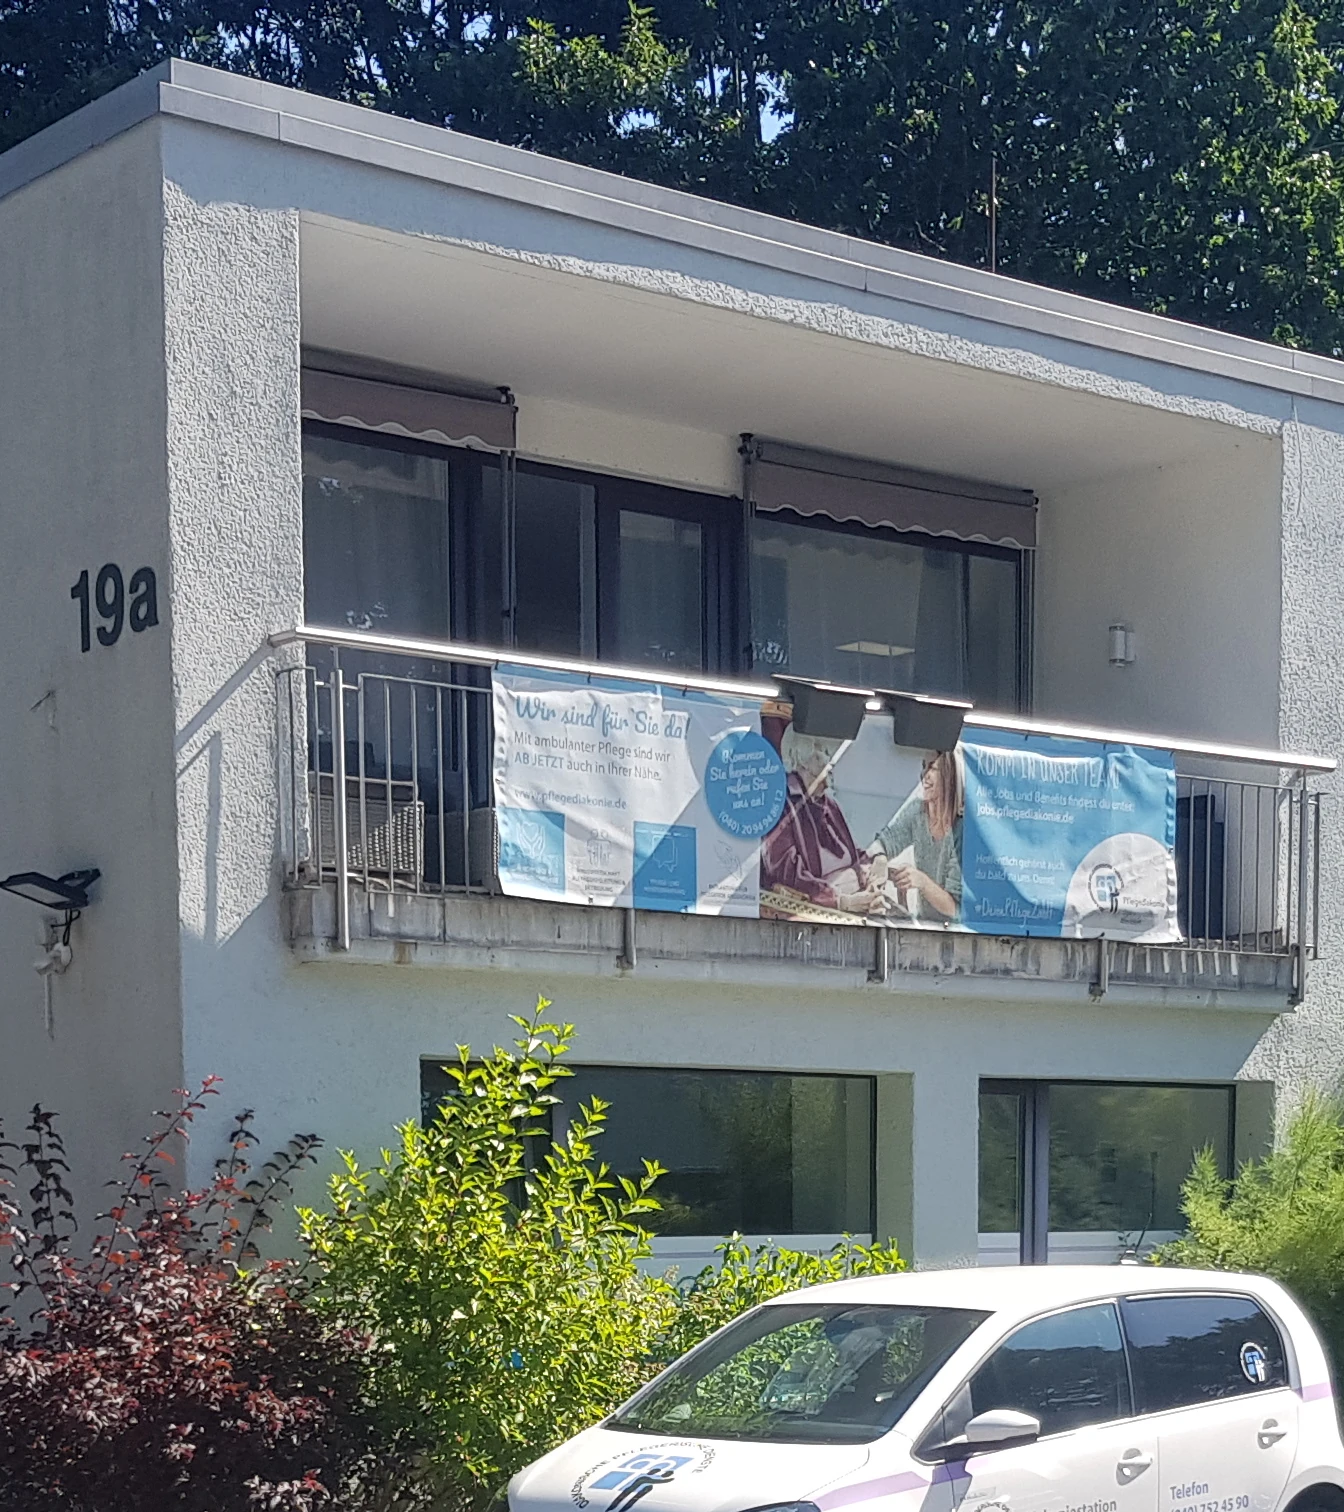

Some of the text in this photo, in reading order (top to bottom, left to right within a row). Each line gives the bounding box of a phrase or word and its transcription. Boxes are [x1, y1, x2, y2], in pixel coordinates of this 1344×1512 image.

[70, 562, 159, 653] 19a
[516, 695, 691, 740] Wir sind für Sie da!
[514, 731, 671, 763] Mit ambulanter Pflege sind wir
[722, 749, 765, 763] Kommen
[514, 752, 530, 766] AB
[532, 755, 564, 770] JETZT
[567, 758, 593, 774] auch
[595, 761, 606, 775] in
[608, 763, 633, 778] Ihrer
[710, 759, 780, 781] Sie herein oder
[977, 750, 1016, 776] KOMM
[1021, 756, 1036, 780] IN
[1040, 758, 1078, 784] UNSER
[726, 777, 768, 798] rufen Sie
[994, 788, 1014, 800] Jobs
[1015, 790, 1033, 802] und
[514, 788, 628, 811] www.pflegediakonie.de
[732, 798, 748, 810] uns
[1170, 1481, 1209, 1501] Telefon
[1221, 1496, 1234, 1512] 45
[1235, 1494, 1249, 1509] 90
